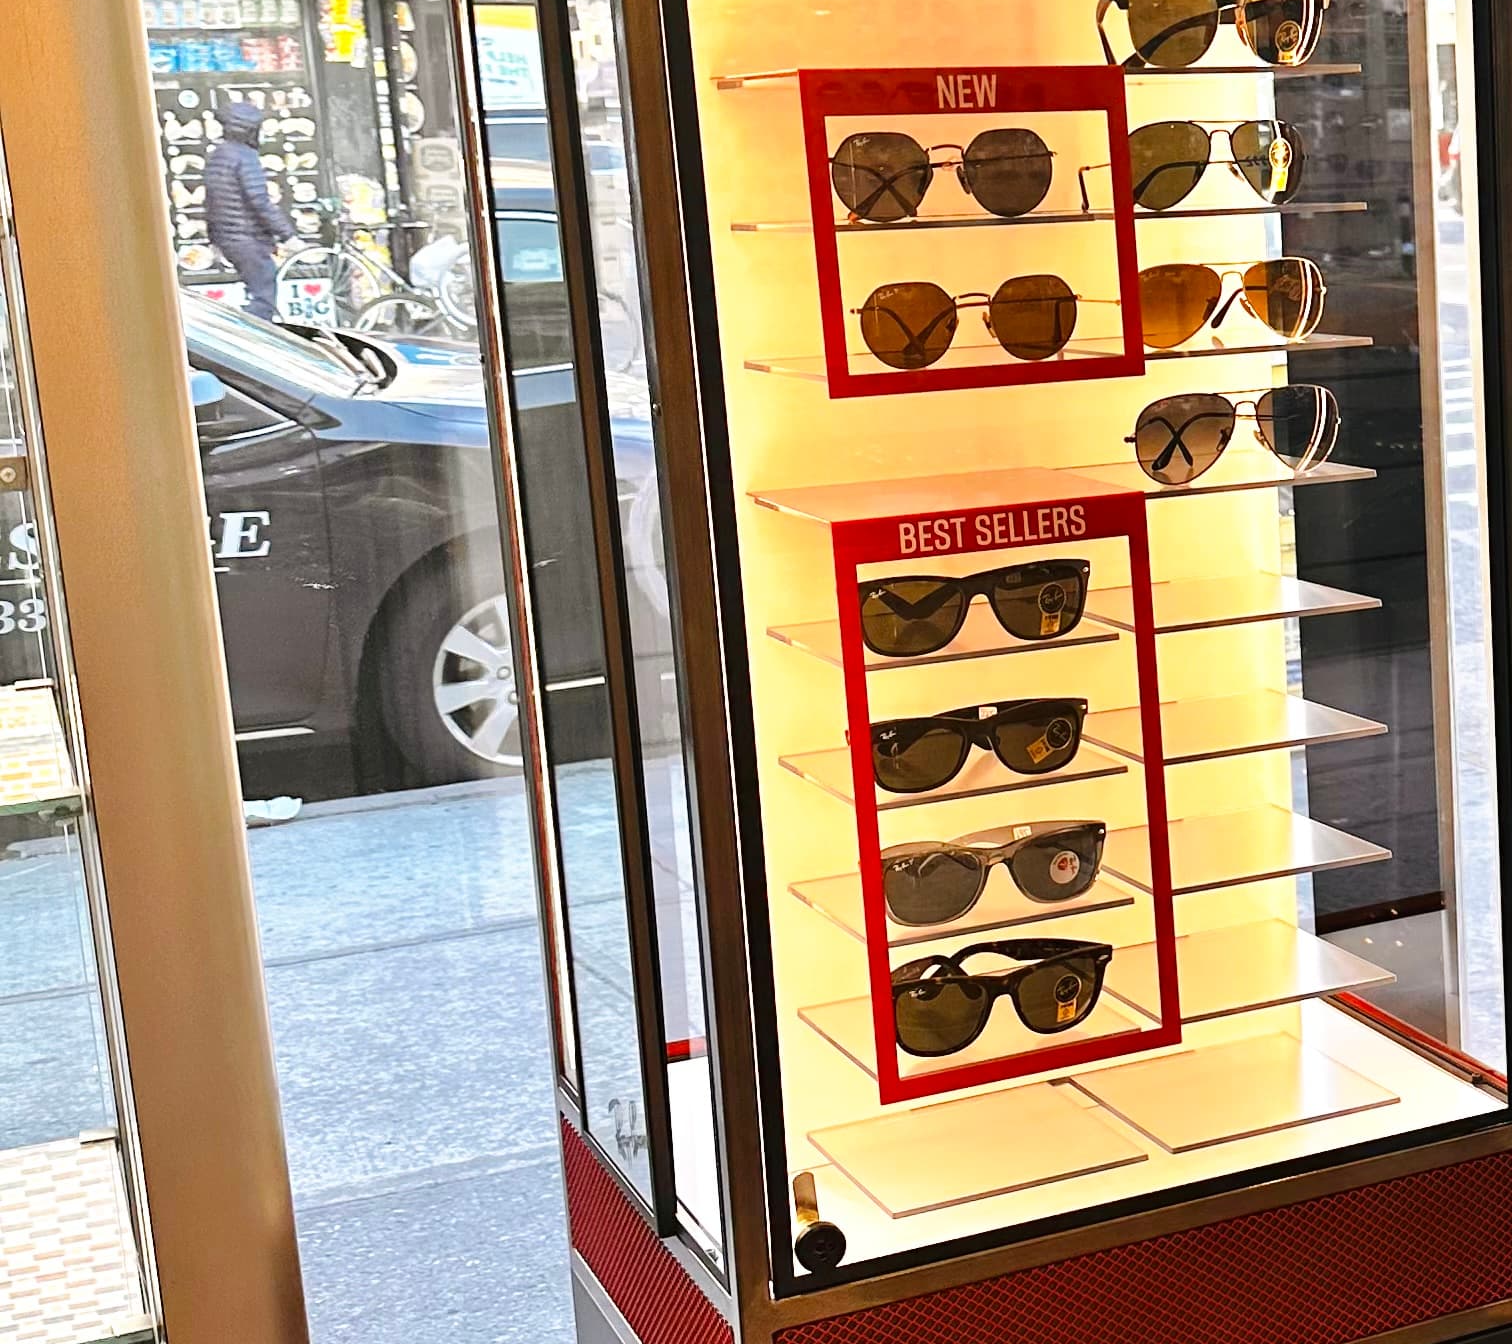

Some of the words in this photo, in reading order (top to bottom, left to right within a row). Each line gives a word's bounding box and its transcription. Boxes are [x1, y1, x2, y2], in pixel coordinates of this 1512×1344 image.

[936, 74, 997, 110] NEW
[898, 517, 967, 554] BEST
[974, 504, 1088, 546] SELLERS
